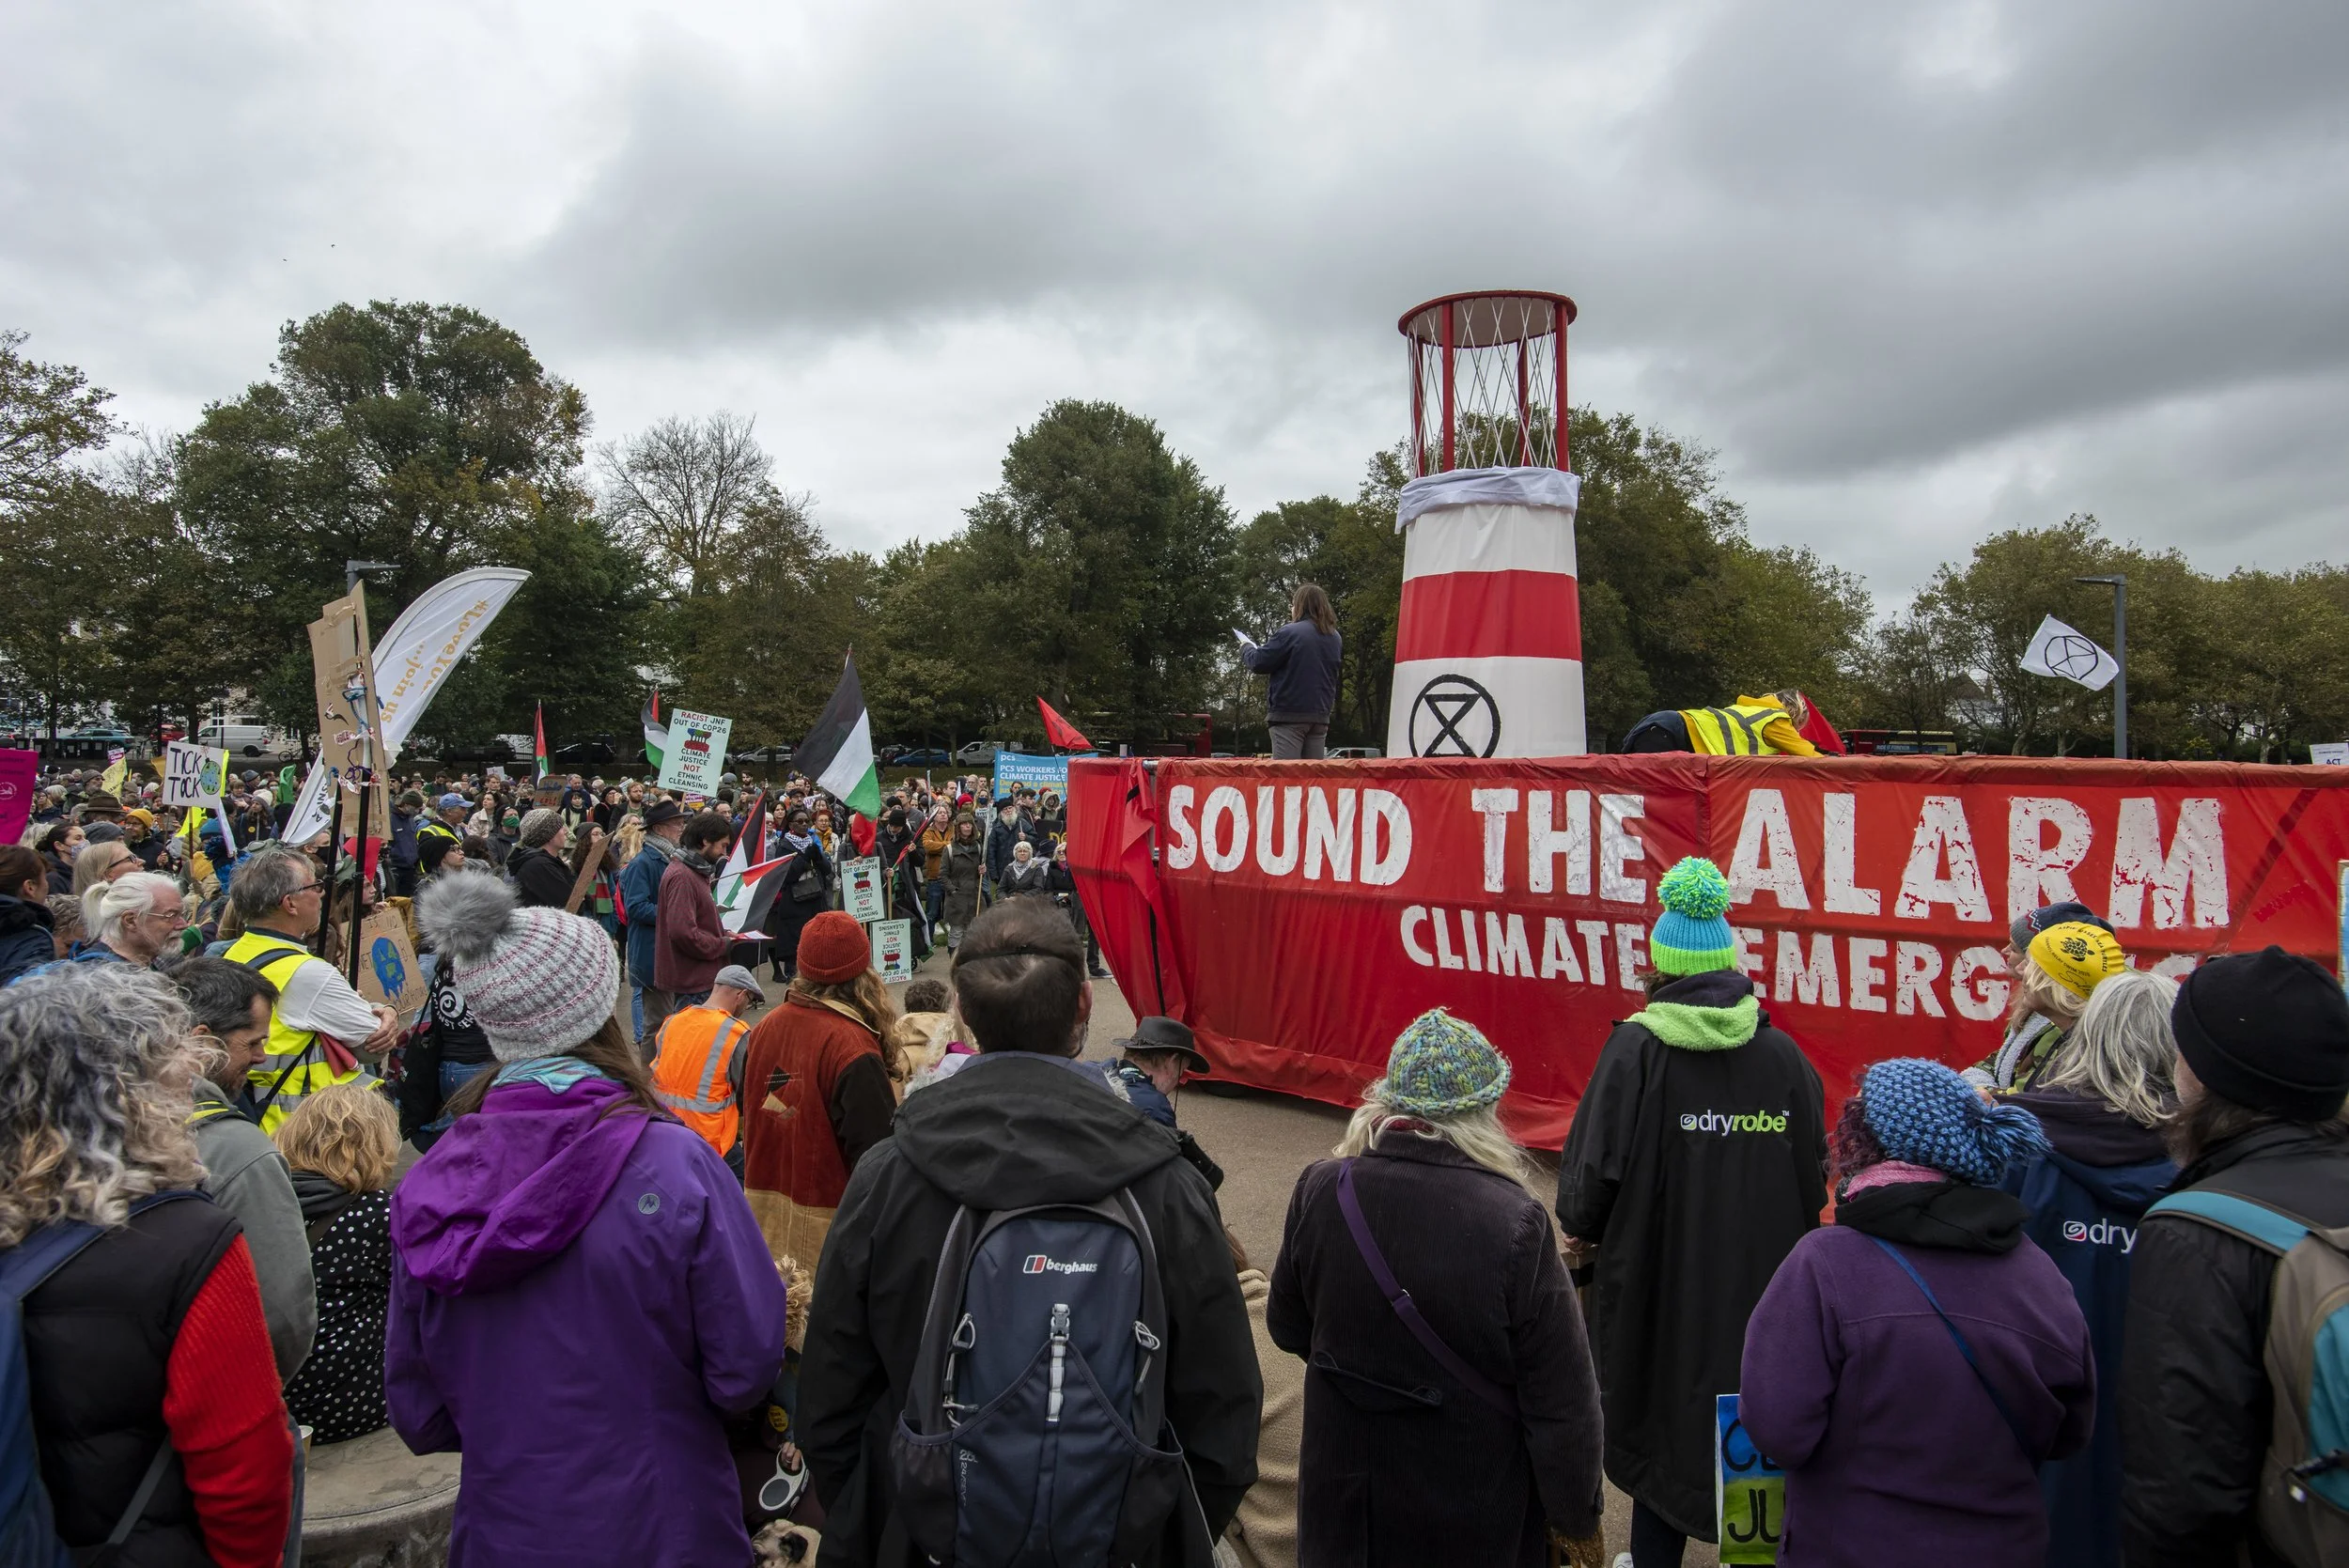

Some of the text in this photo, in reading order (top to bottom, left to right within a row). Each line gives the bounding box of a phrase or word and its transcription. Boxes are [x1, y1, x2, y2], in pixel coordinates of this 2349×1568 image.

[381, 702, 399, 724] us
[681, 711, 725, 726] RACIST JNF
[674, 718, 688, 726] OUT
[702, 723, 727, 734] COP26
[170, 747, 203, 775] TICK
[678, 755, 708, 766] JUSTICE
[681, 748, 711, 759] CLIMATE
[683, 764, 701, 772] NOT
[668, 777, 708, 790] CLEANSING
[677, 771, 703, 782] ETHNIC
[168, 776, 201, 802] TOCK
[1167, 784, 2231, 930] SOUND THE ALARM
[854, 886, 874, 894] CLIMATE
[879, 923, 905, 932] CLEANSING
[1399, 905, 2197, 1021] CLIMATE EMERG
[889, 974, 907, 983] RACIST
[1698, 1109, 1787, 1137] dryrobe
[1046, 1258, 1098, 1275] berghaus
[1727, 1488, 1785, 1544] JU
